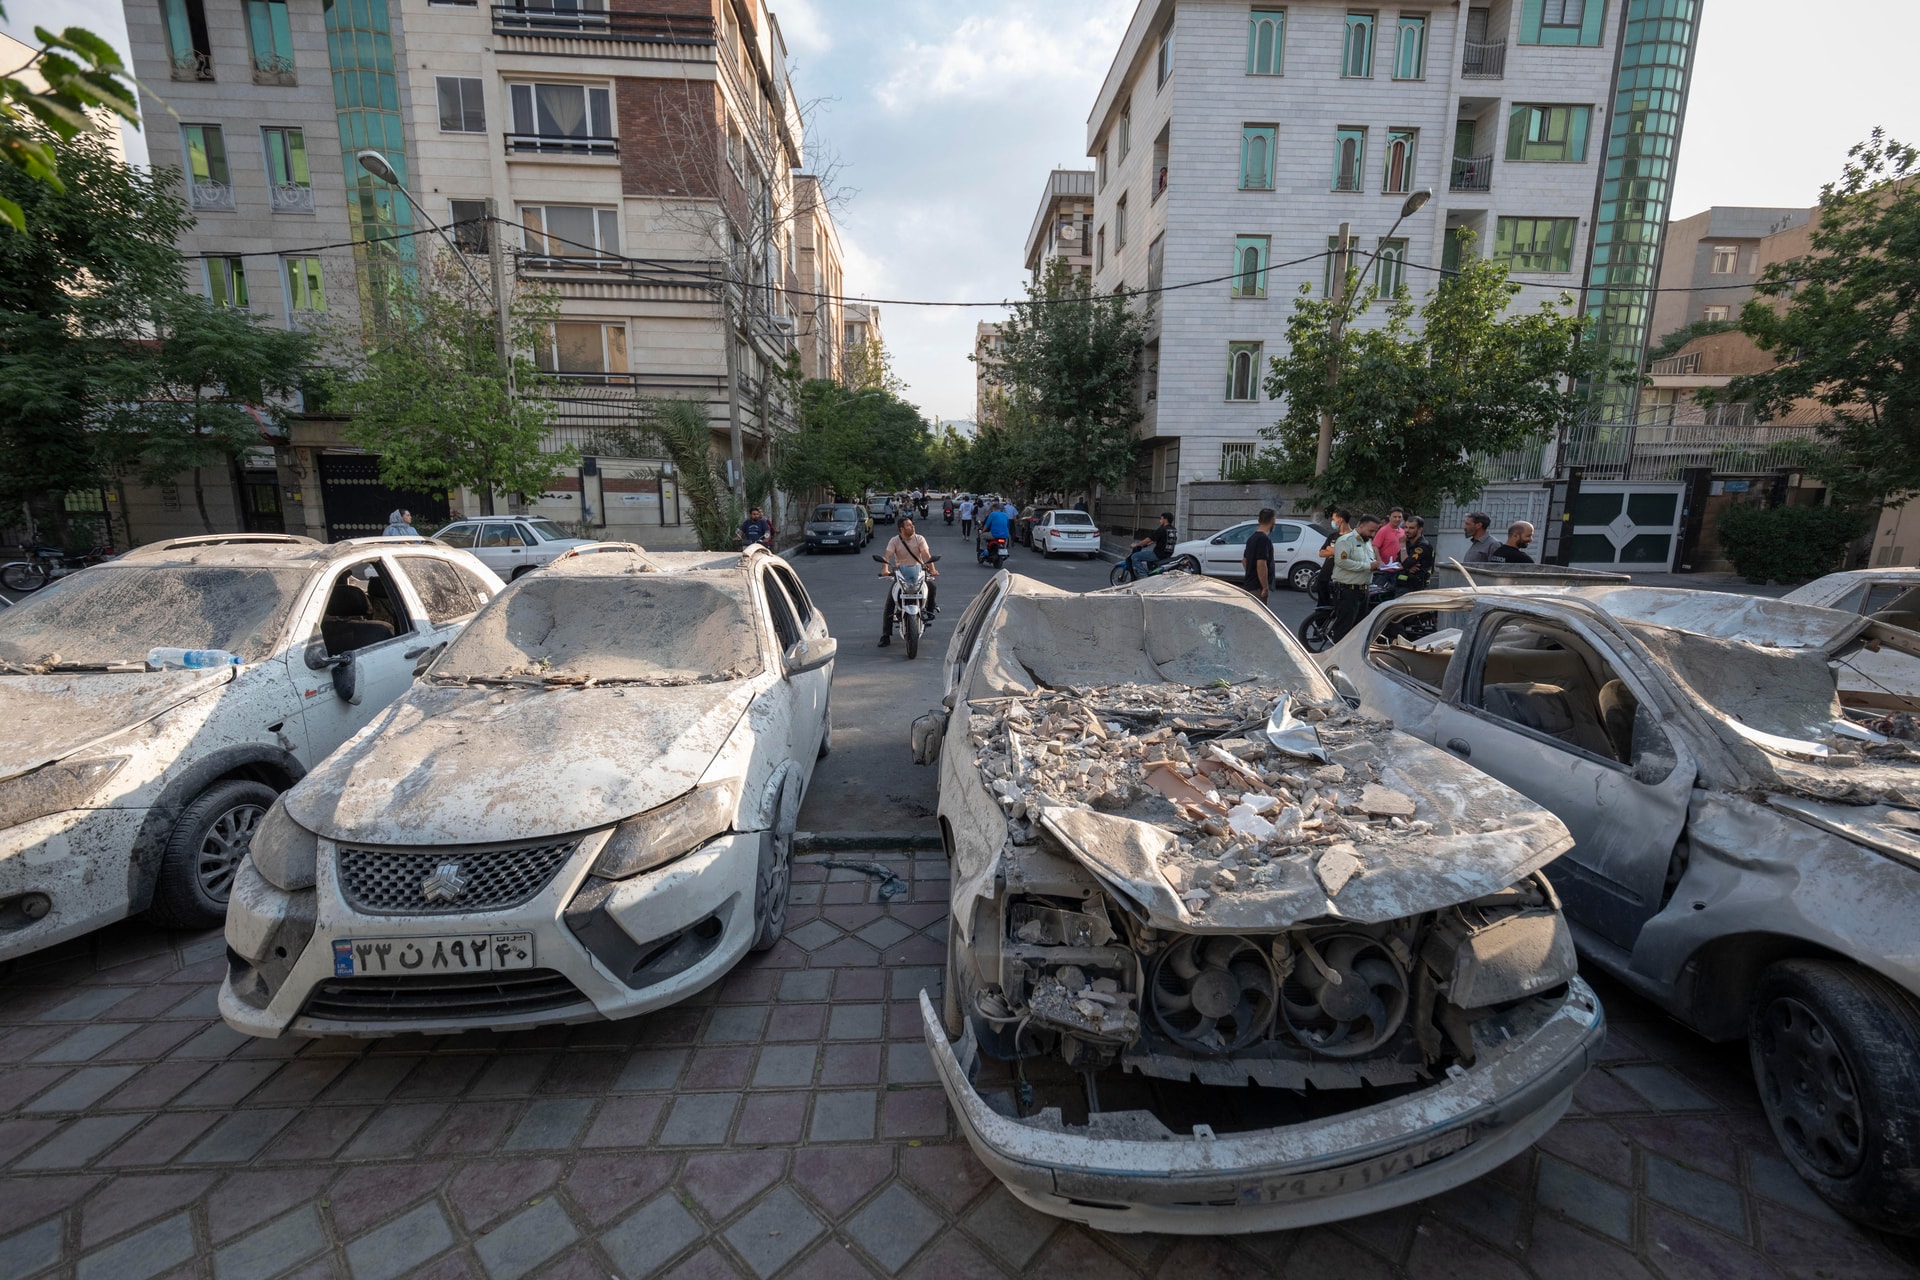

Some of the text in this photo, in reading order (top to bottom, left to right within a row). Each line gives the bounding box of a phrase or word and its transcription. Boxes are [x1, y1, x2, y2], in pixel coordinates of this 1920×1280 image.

[355, 939, 528, 971] ۳۳ ن ۸۹۲ ۴۰
